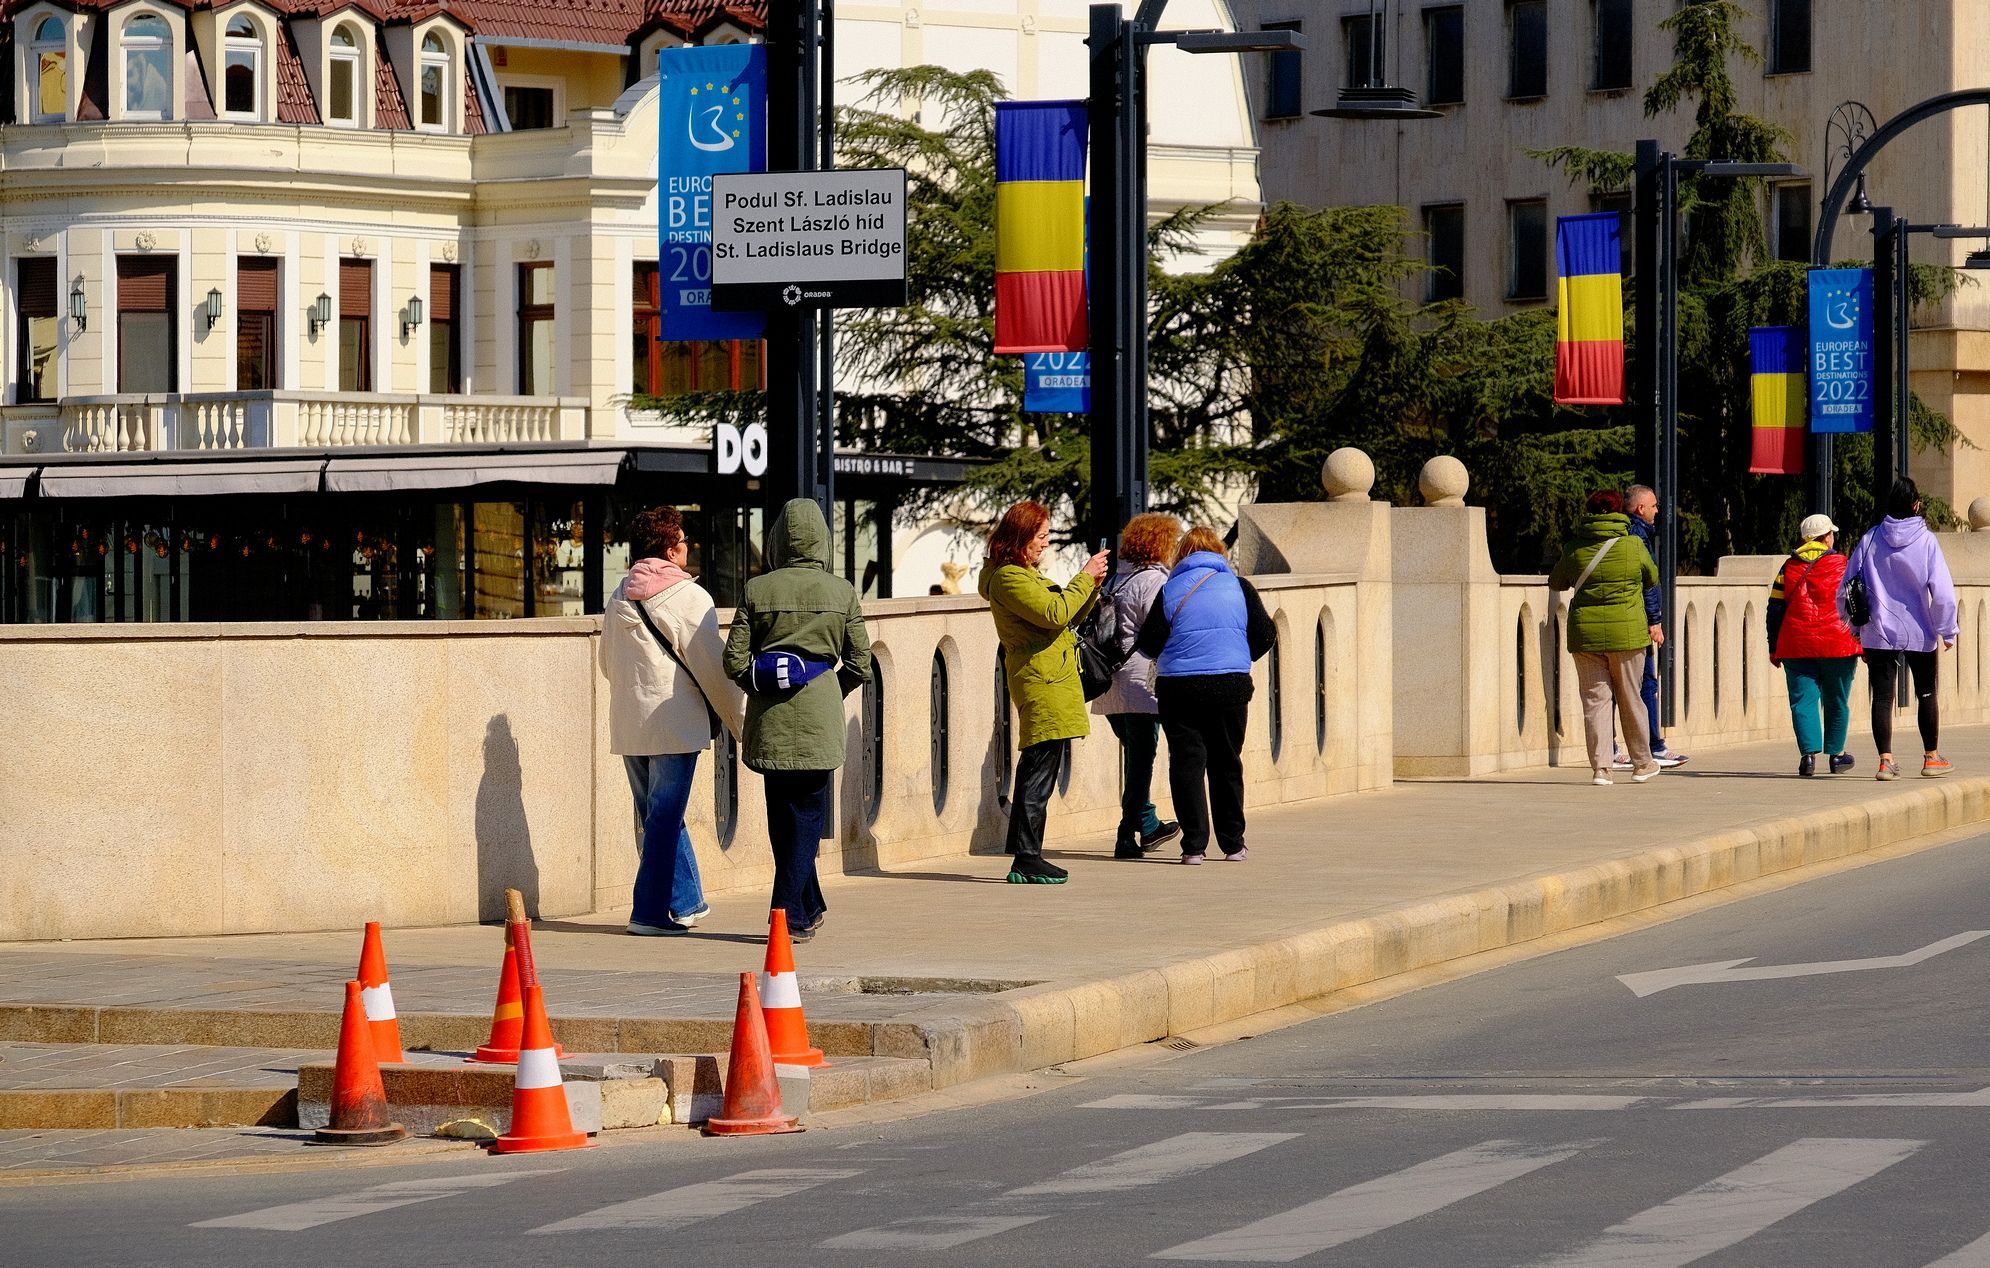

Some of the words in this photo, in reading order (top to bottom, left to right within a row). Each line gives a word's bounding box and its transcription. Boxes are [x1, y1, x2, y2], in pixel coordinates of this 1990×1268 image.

[725, 192, 778, 209] Podul
[783, 191, 808, 207] Sf.
[814, 189, 892, 207] Ladislau
[669, 195, 711, 228] BE
[733, 217, 785, 234] Szent
[790, 215, 850, 232] László
[856, 214, 884, 230] híd
[715, 243, 740, 259] St.
[746, 241, 835, 257] Ladislaus
[841, 239, 902, 258] Bridge
[1816, 341, 1868, 352] EUROPEAN
[1031, 352, 1091, 370] 202
[1816, 352, 1868, 371] BEST
[1044, 377, 1087, 386] ORADEA
[1816, 371, 1868, 380] DESTINATIONS
[1817, 380, 1869, 401] 2022
[1826, 405, 1859, 413] ORADEA
[834, 458, 872, 474] BISTRO
[873, 460, 880, 472] &
[881, 460, 903, 475] BAR
